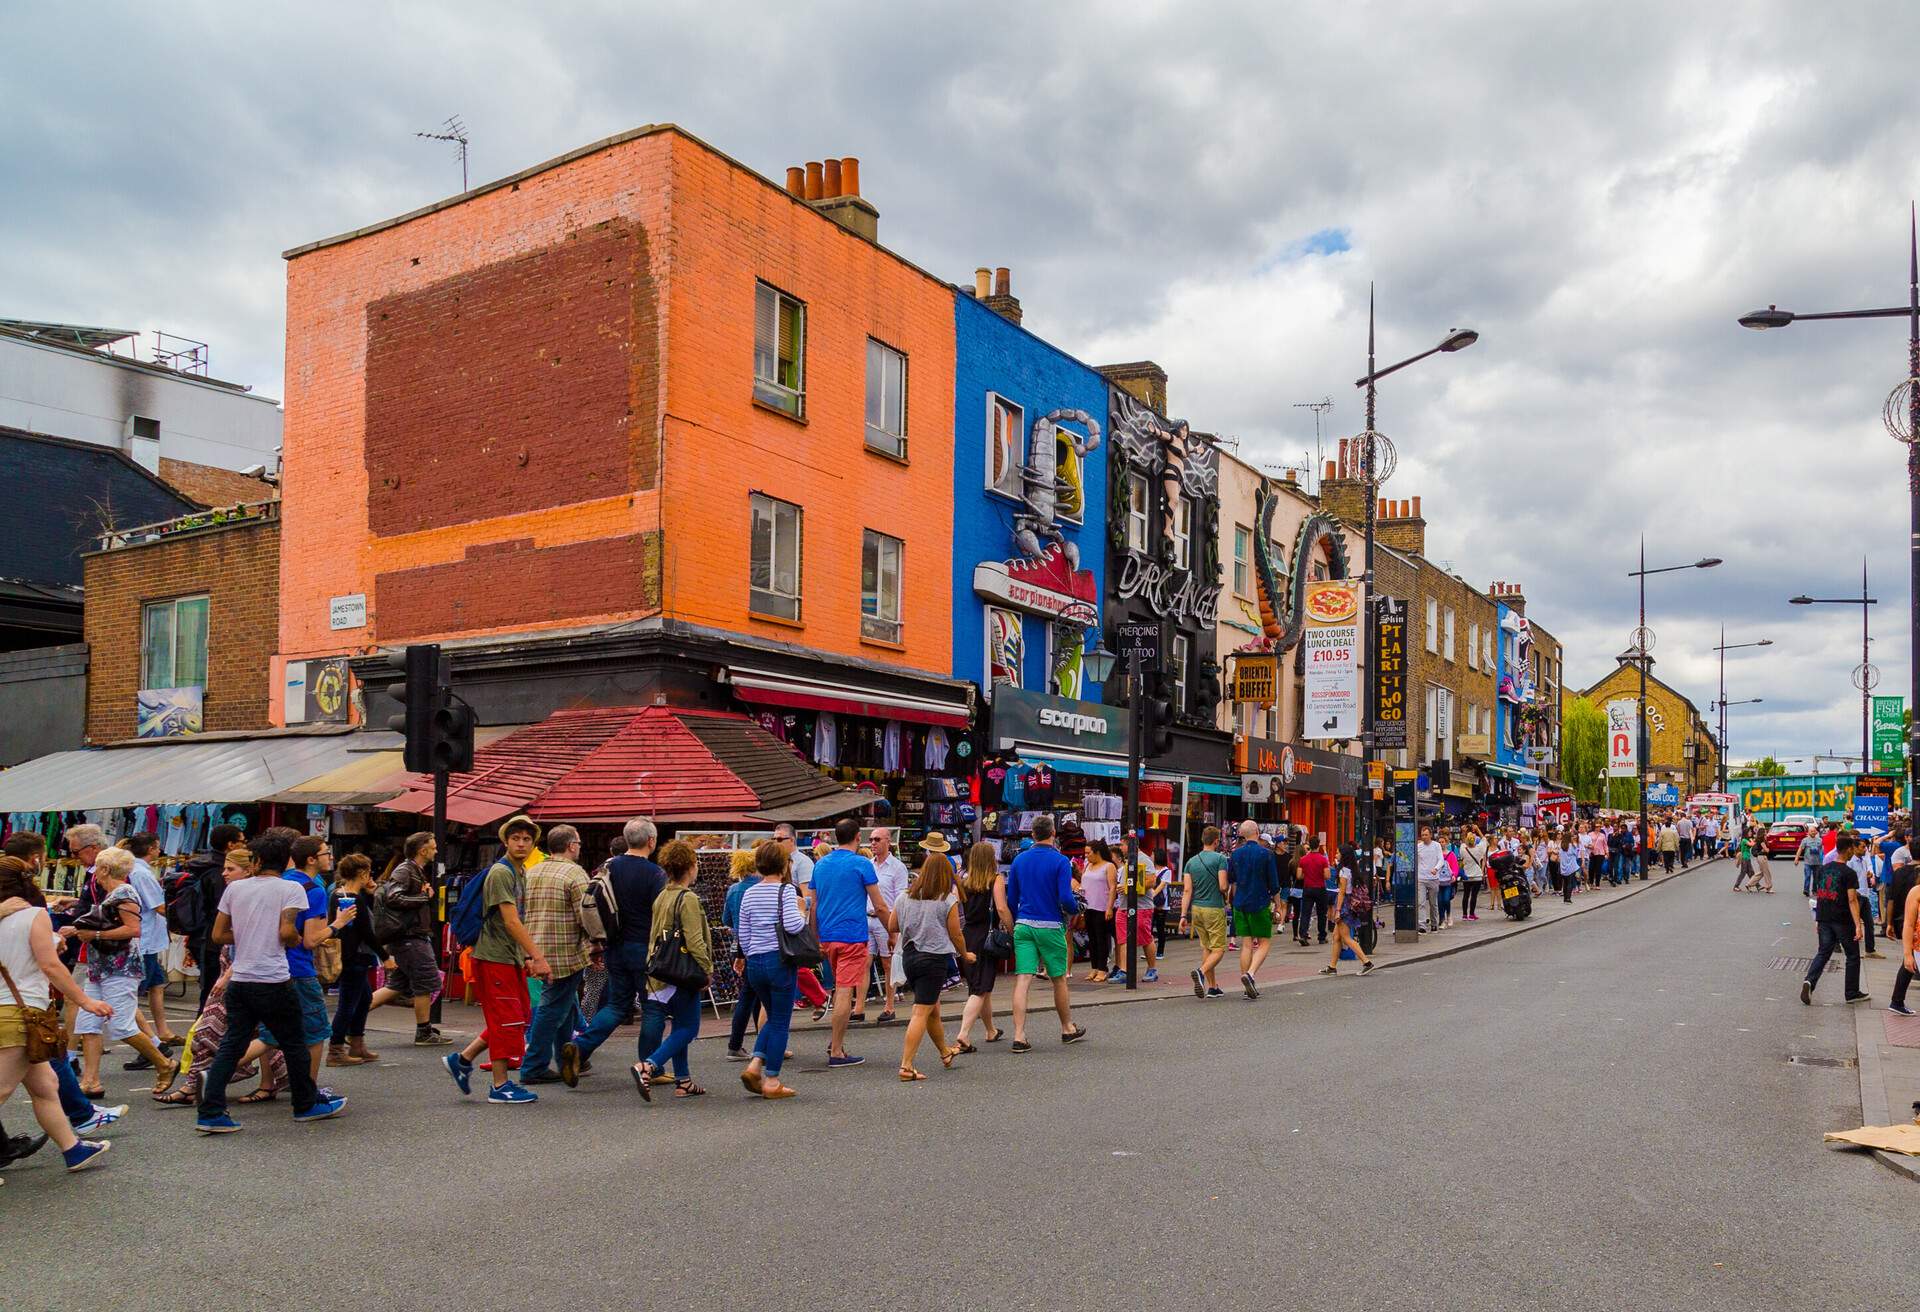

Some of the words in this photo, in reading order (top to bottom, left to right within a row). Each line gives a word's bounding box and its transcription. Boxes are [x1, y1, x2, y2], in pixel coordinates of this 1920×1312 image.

[1119, 549, 1173, 617] DARK
[332, 602, 364, 614] JAMESTOWN
[332, 616, 348, 625] ROAD
[1379, 614, 1404, 624] Skin
[1120, 626, 1158, 636] PIERCING
[1307, 630, 1324, 639] TWO
[1326, 629, 1355, 638] COURSE
[1135, 637, 1142, 646] &
[1307, 639, 1331, 648] LUNCH
[1333, 638, 1355, 647] DEAL!
[1313, 650, 1350, 662] £10.95
[1240, 666, 1272, 680] ORIENTAL
[1240, 682, 1272, 698] BUFFET
[1876, 704, 1900, 713] FISH
[1040, 708, 1107, 735] scorpion
[1539, 797, 1570, 805] Clearance
[1745, 788, 1835, 811] CAMDEN
